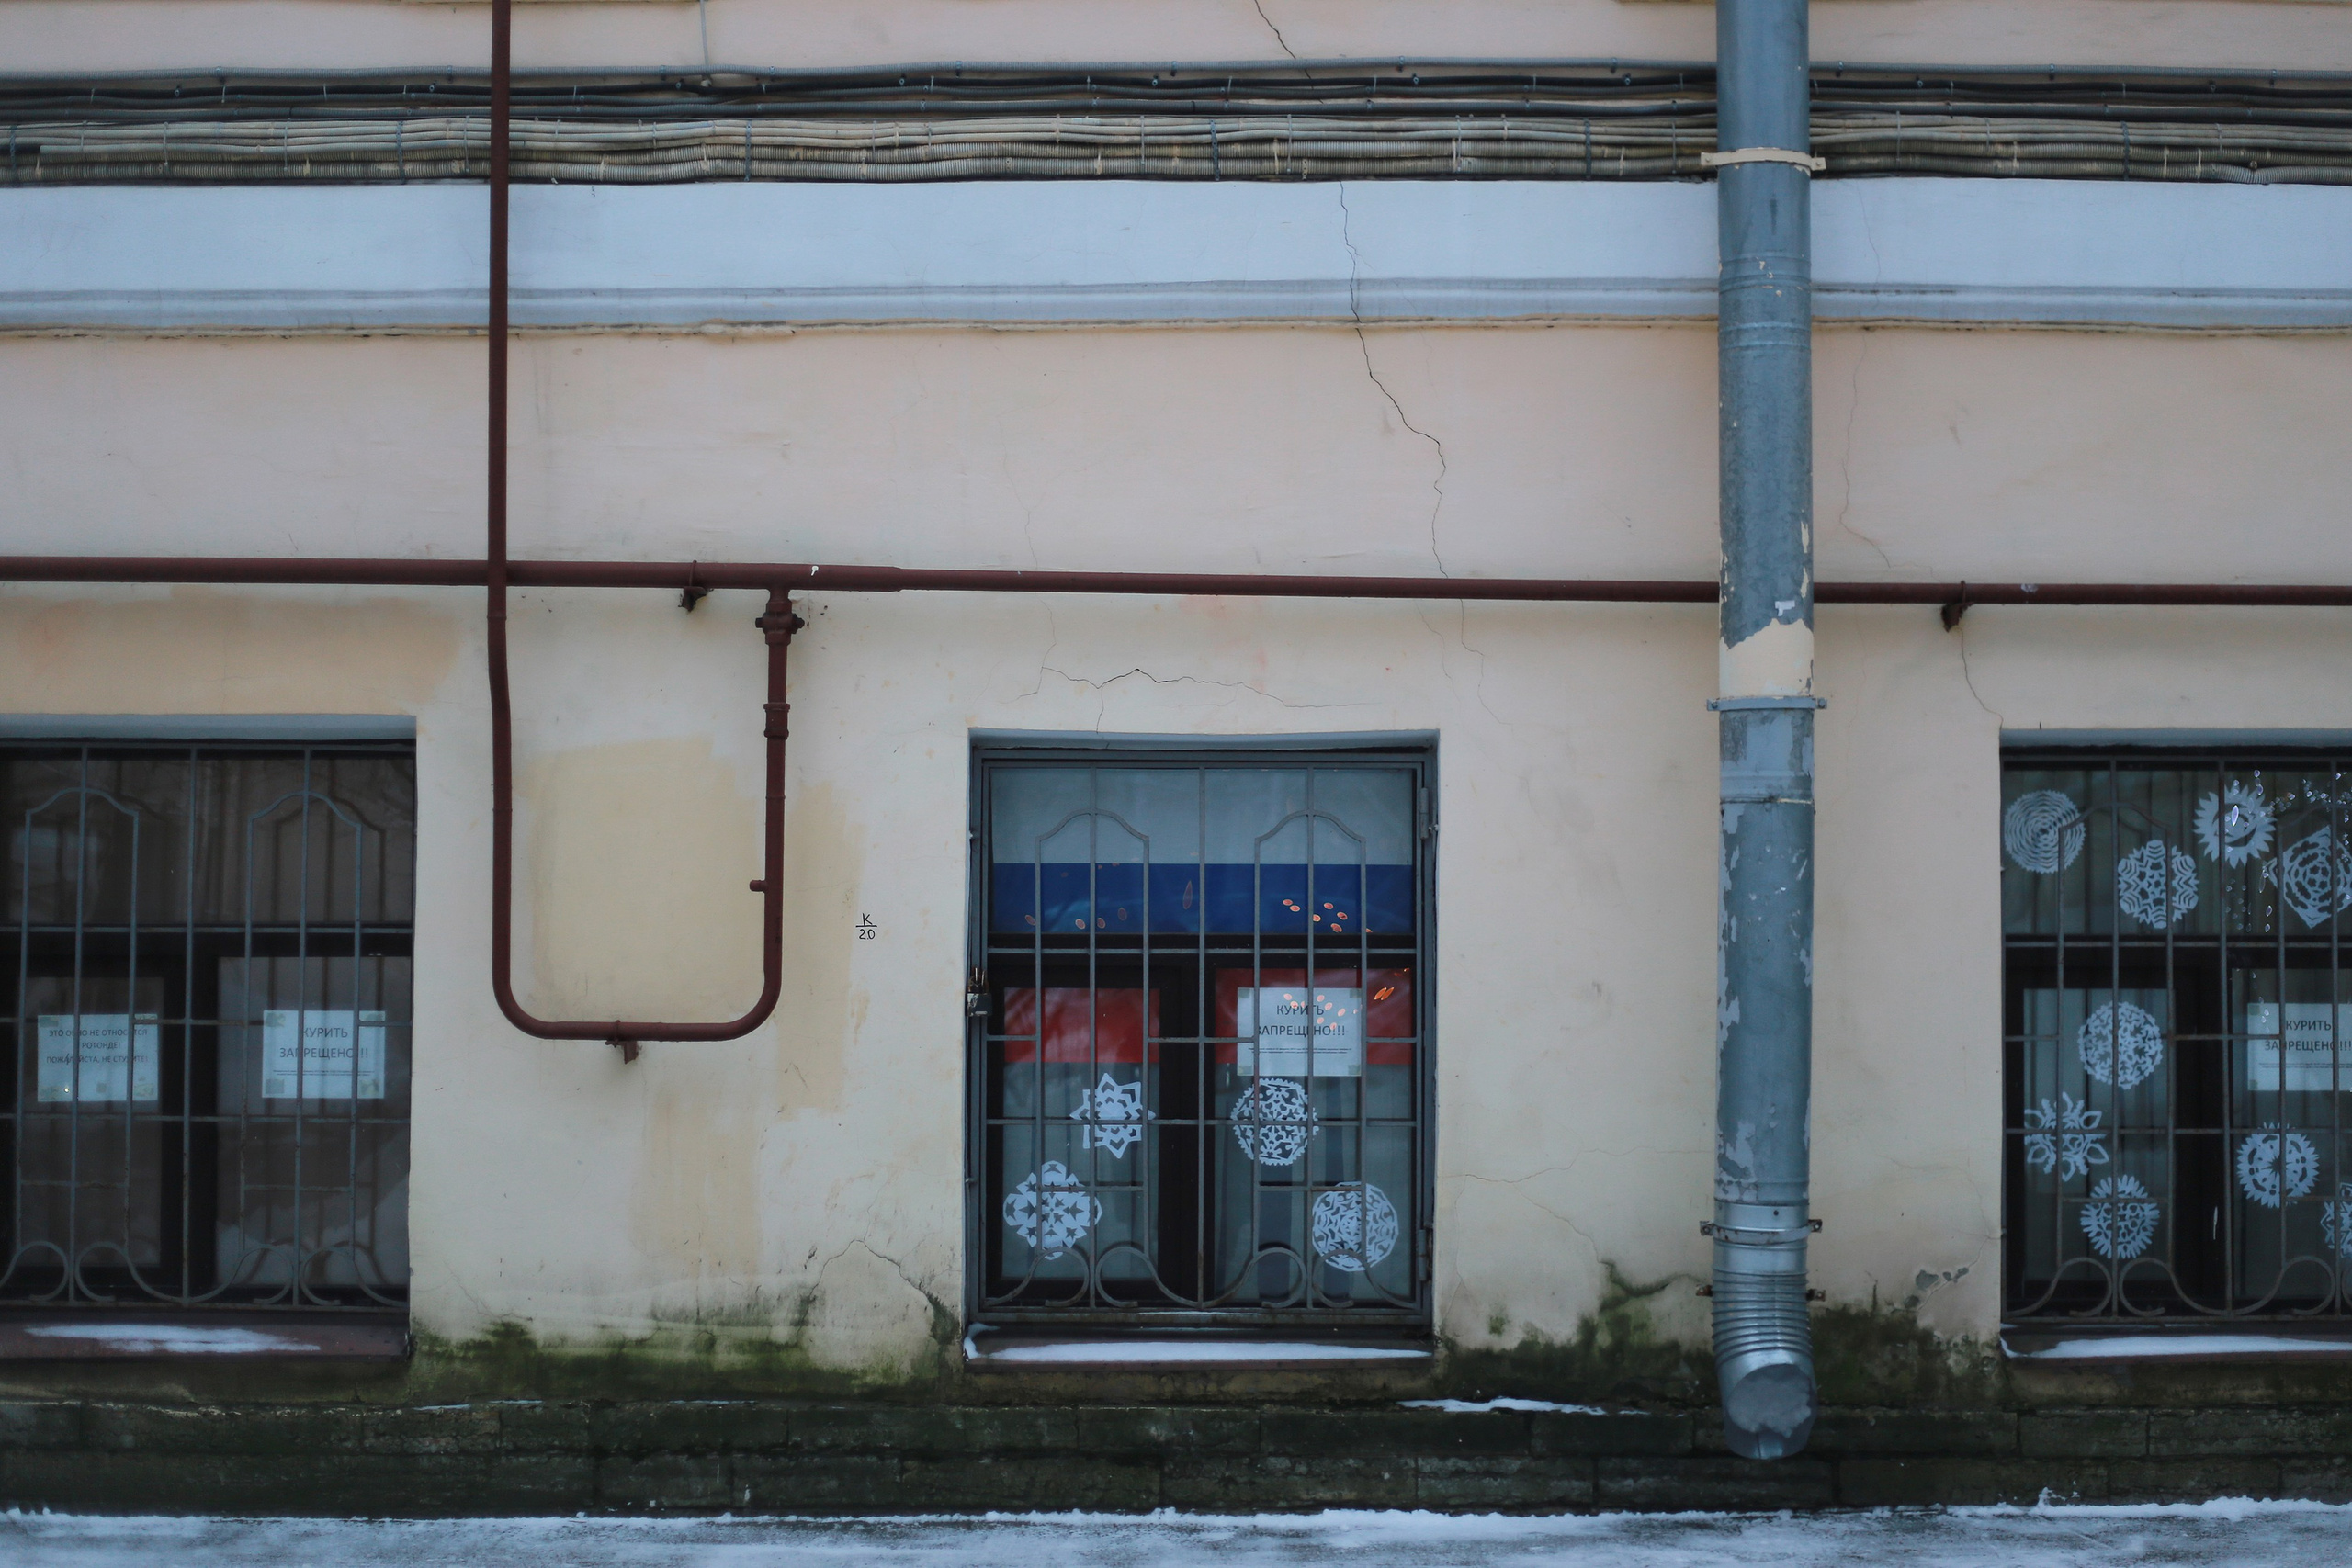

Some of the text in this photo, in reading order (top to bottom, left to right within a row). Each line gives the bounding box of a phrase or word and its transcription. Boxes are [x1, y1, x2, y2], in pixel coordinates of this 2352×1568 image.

[1276, 1005, 1325, 1016] КУРИЬ
[2286, 1020, 2332, 1031] КУРИТЬ
[49, 1029, 64, 1037] ЭТО
[89, 1029, 99, 1037] НЕ
[101, 1028, 148, 1037] ОТНОСТСЯ
[101, 1055, 111, 1064] НЕ
